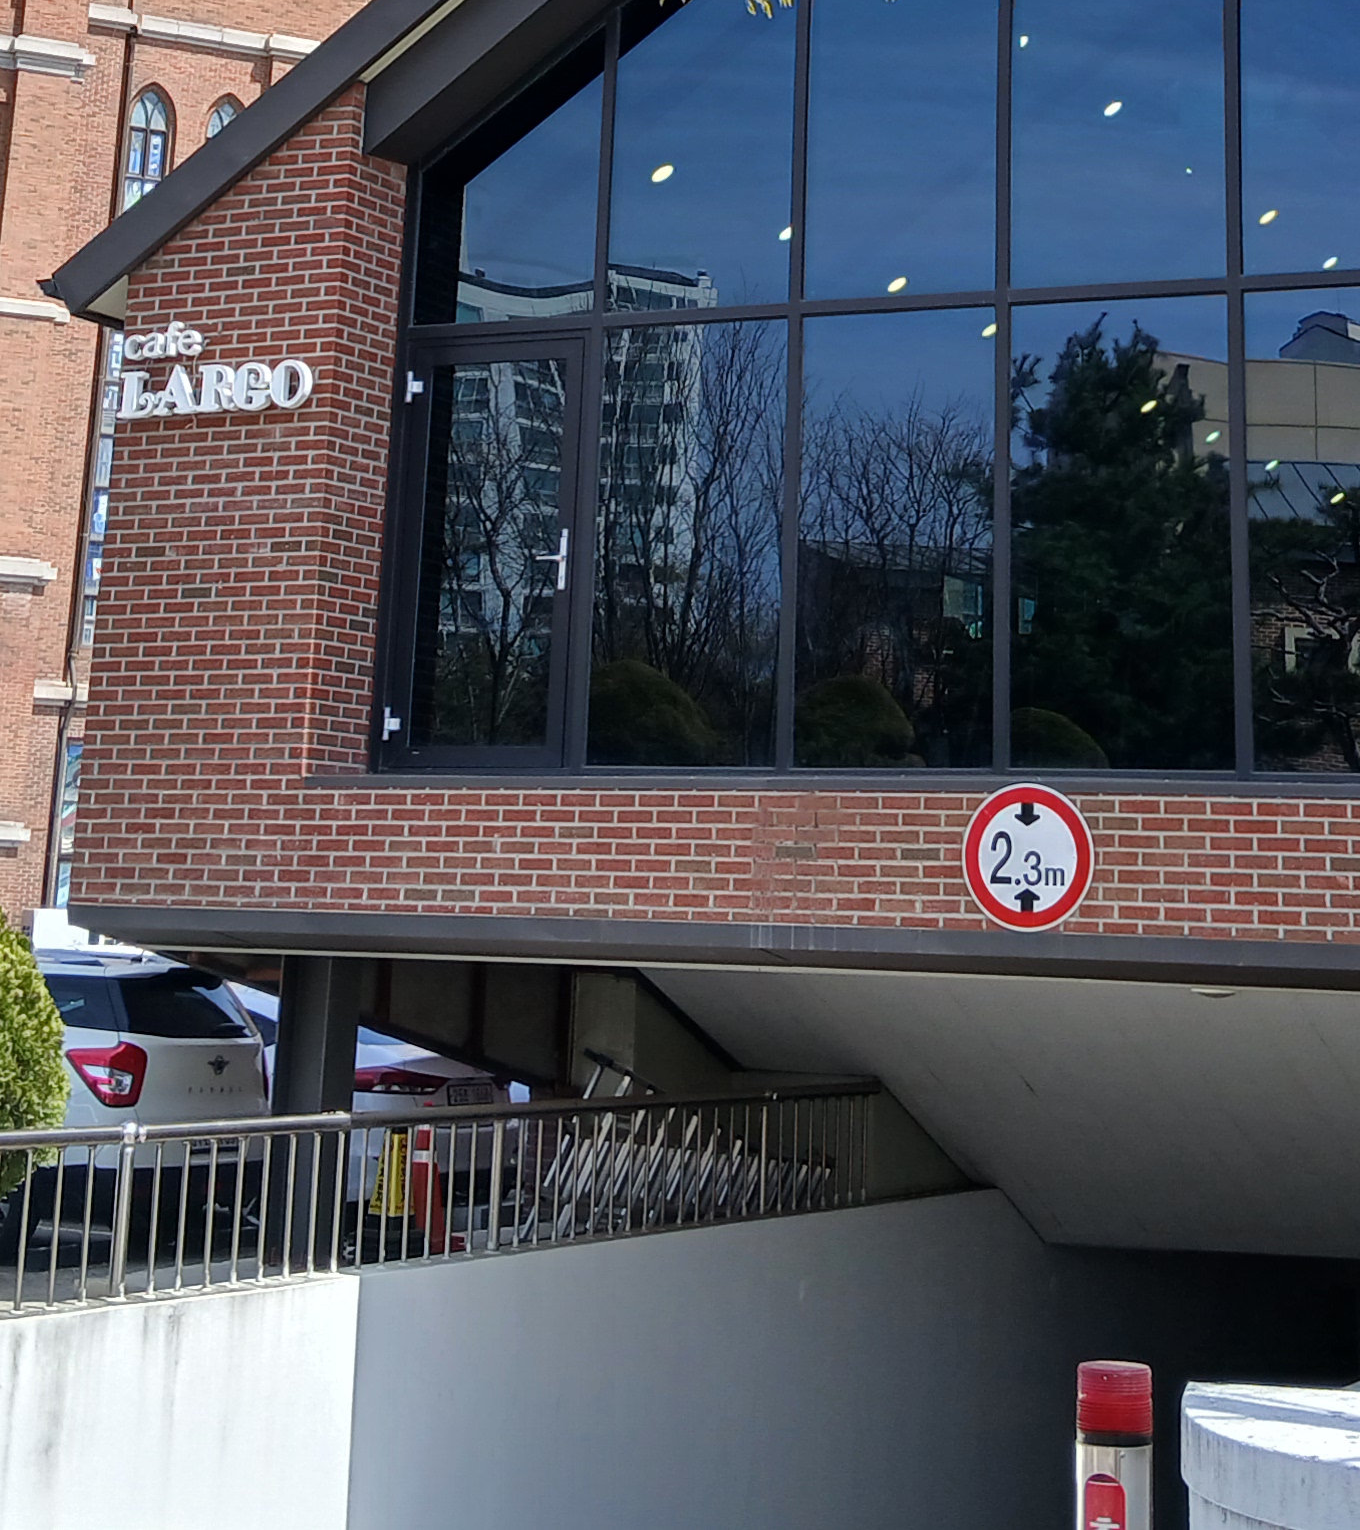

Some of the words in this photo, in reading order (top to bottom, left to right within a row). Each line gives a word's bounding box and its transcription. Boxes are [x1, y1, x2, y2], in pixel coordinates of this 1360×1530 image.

[124, 321, 203, 361] cafe
[117, 359, 313, 420] LARGO
[990, 831, 1065, 886] 2.3m
